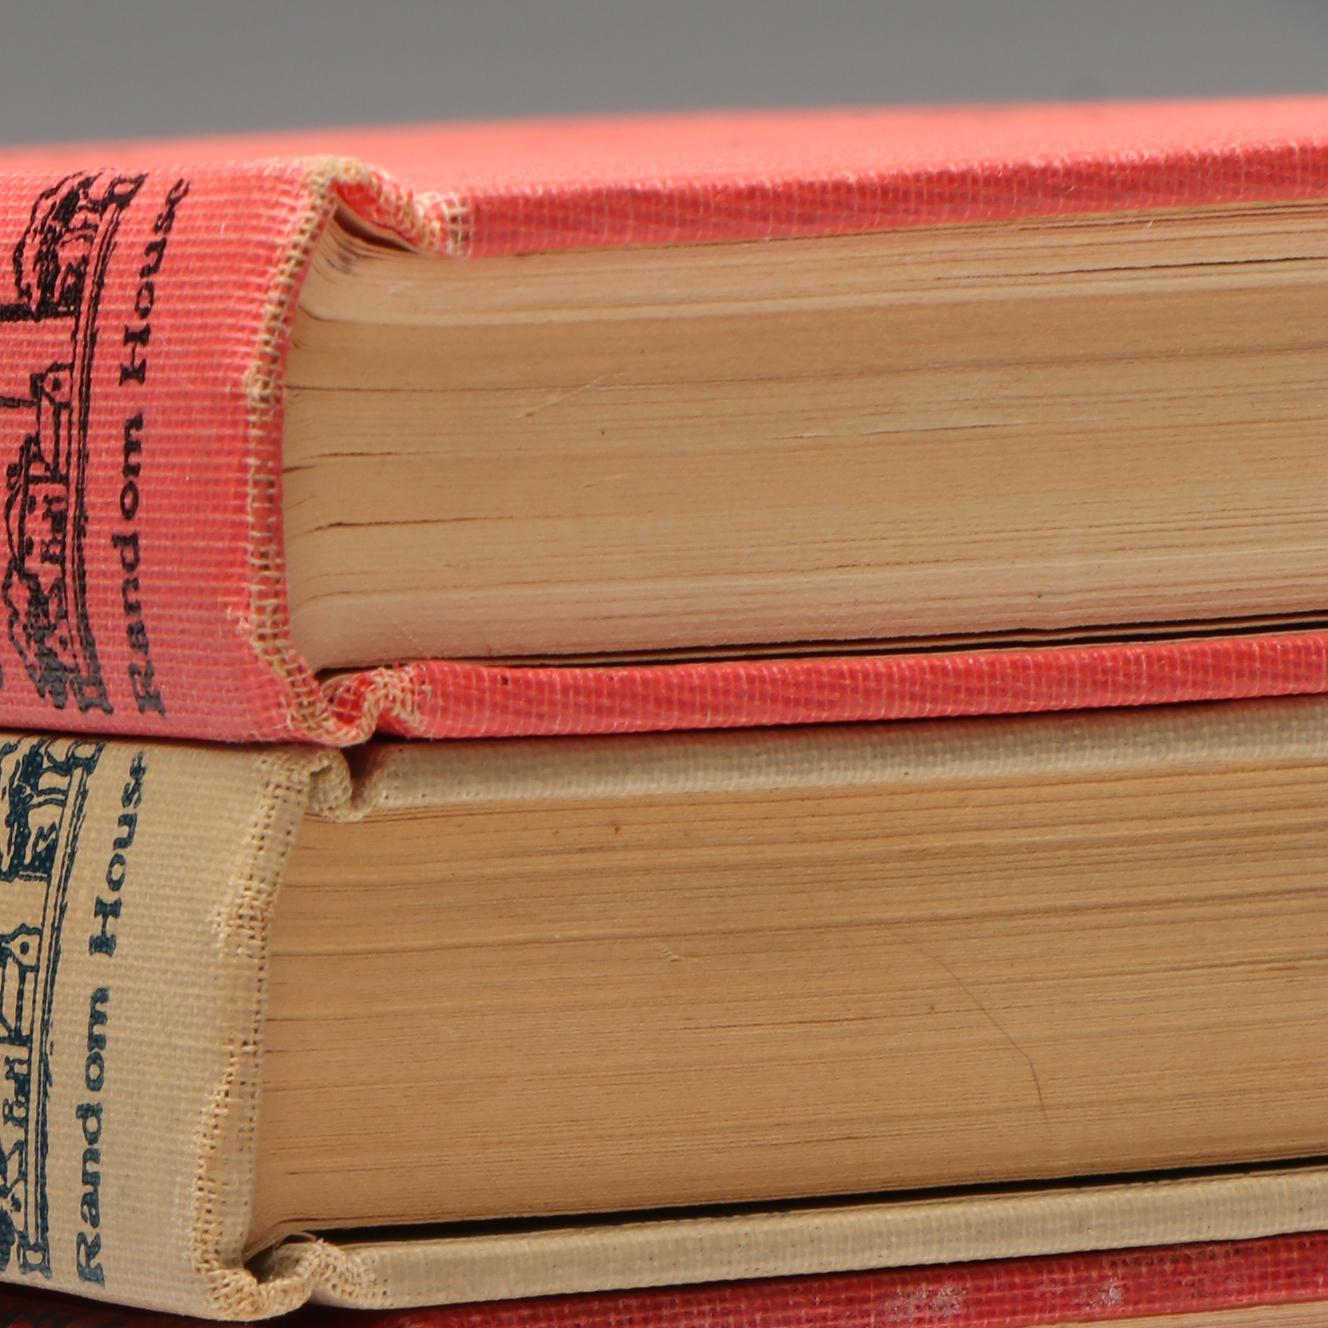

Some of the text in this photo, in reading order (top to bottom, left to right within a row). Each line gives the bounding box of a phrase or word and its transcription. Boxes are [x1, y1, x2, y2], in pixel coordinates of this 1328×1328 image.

[111, 178, 190, 717] Random House
[75, 986, 111, 1287] Random
